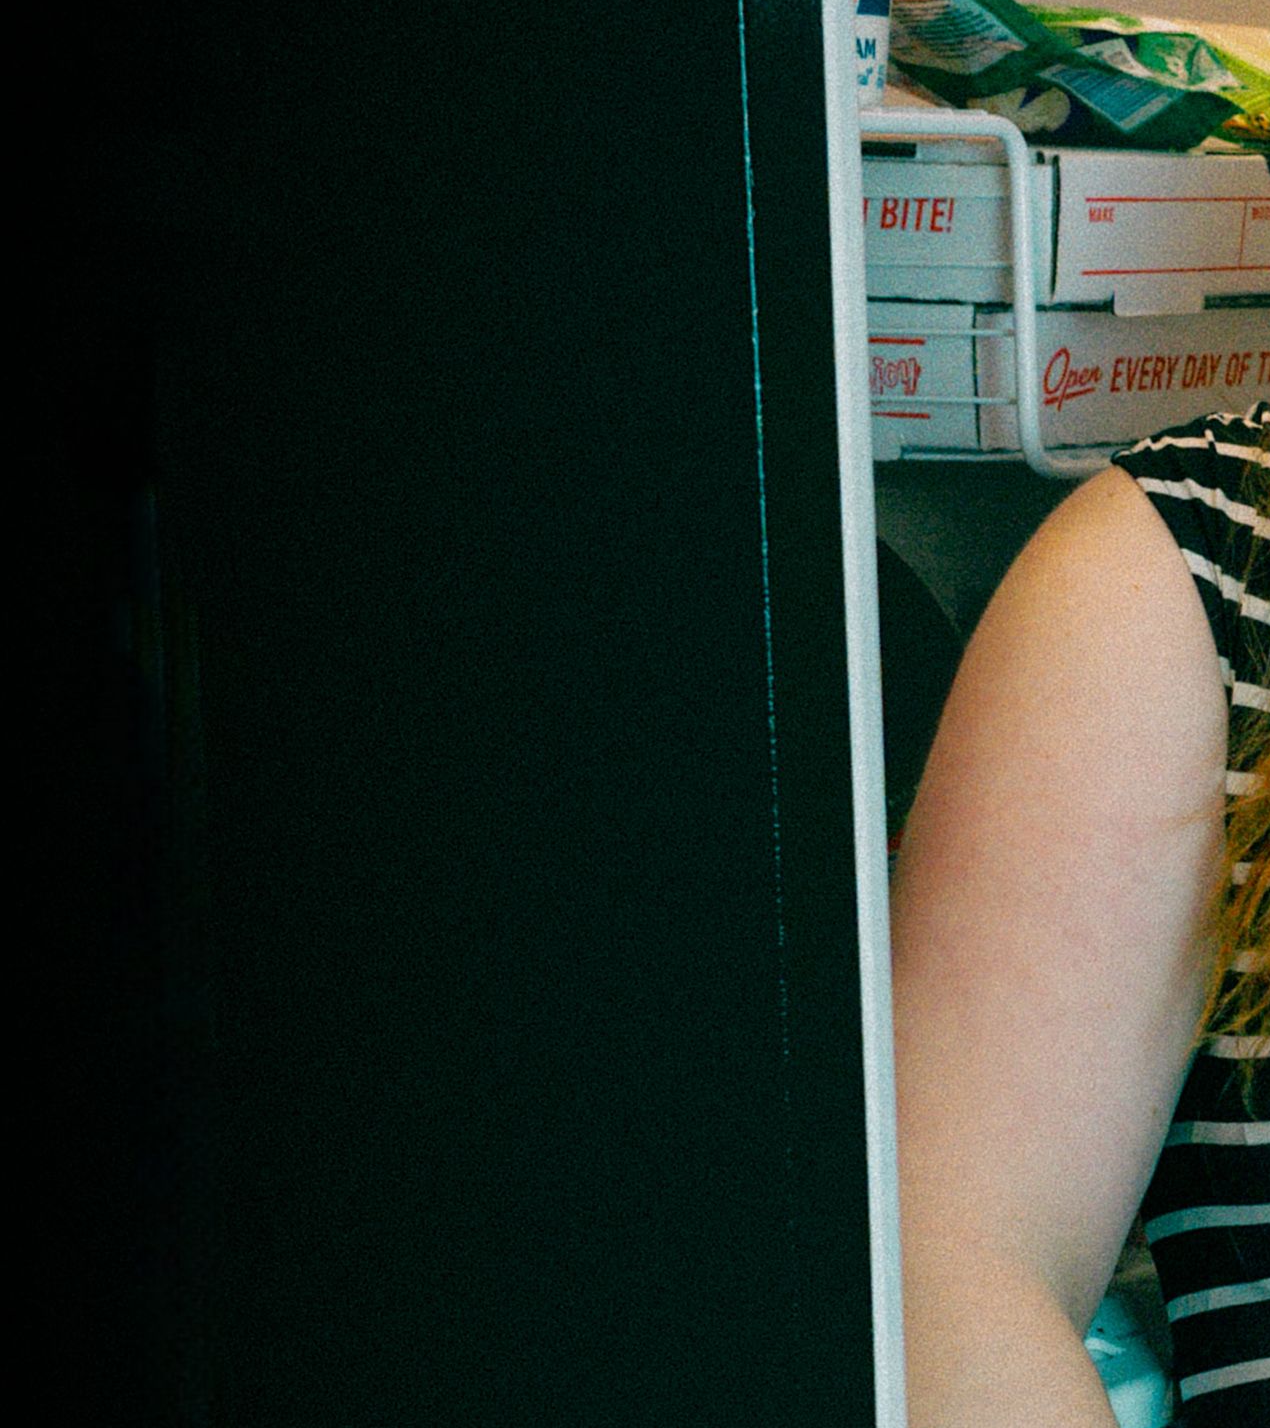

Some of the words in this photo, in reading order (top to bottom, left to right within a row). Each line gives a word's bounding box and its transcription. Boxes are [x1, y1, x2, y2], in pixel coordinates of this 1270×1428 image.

[880, 197, 954, 233] BITE!
[1088, 207, 1115, 222] MAKE
[1043, 347, 1102, 411] Open
[1109, 352, 1180, 393] EVERY
[1181, 351, 1223, 389] DAY
[1224, 350, 1251, 387] OF
